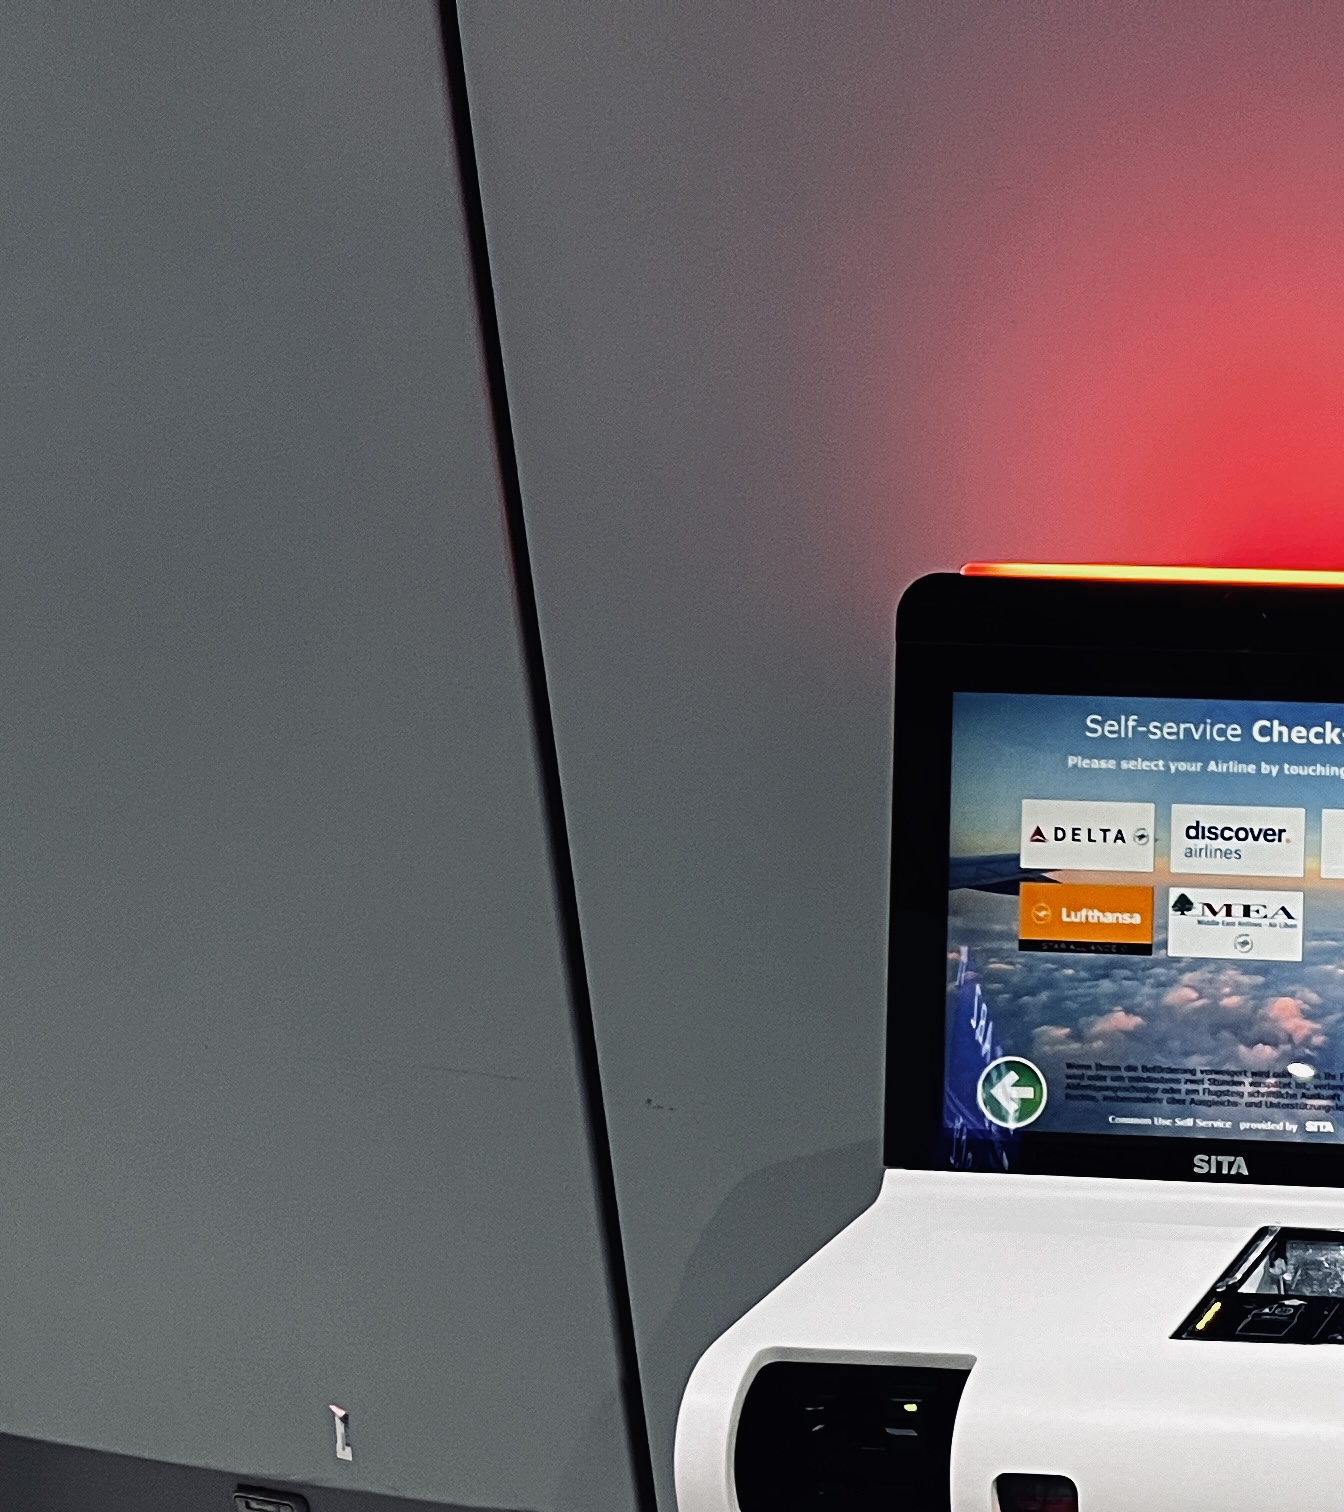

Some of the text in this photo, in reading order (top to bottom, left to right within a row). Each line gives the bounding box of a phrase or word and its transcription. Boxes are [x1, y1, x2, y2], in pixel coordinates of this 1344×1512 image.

[1085, 714, 1242, 743] Self-service
[1067, 755, 1116, 770] Please
[1121, 758, 1164, 772] select
[1169, 760, 1202, 774] your
[1207, 760, 1256, 775] Airline
[1261, 762, 1279, 777] by
[1054, 826, 1126, 844] DELTA
[1184, 844, 1241, 860] airlines
[1061, 908, 1141, 925] Lufthansa
[1201, 902, 1296, 920] MEA
[1196, 1119, 1232, 1128] Service
[1239, 1121, 1284, 1131] provided
[1285, 1121, 1298, 1133] by
[1305, 1120, 1334, 1133] SITA
[1193, 1154, 1249, 1175] SITA
